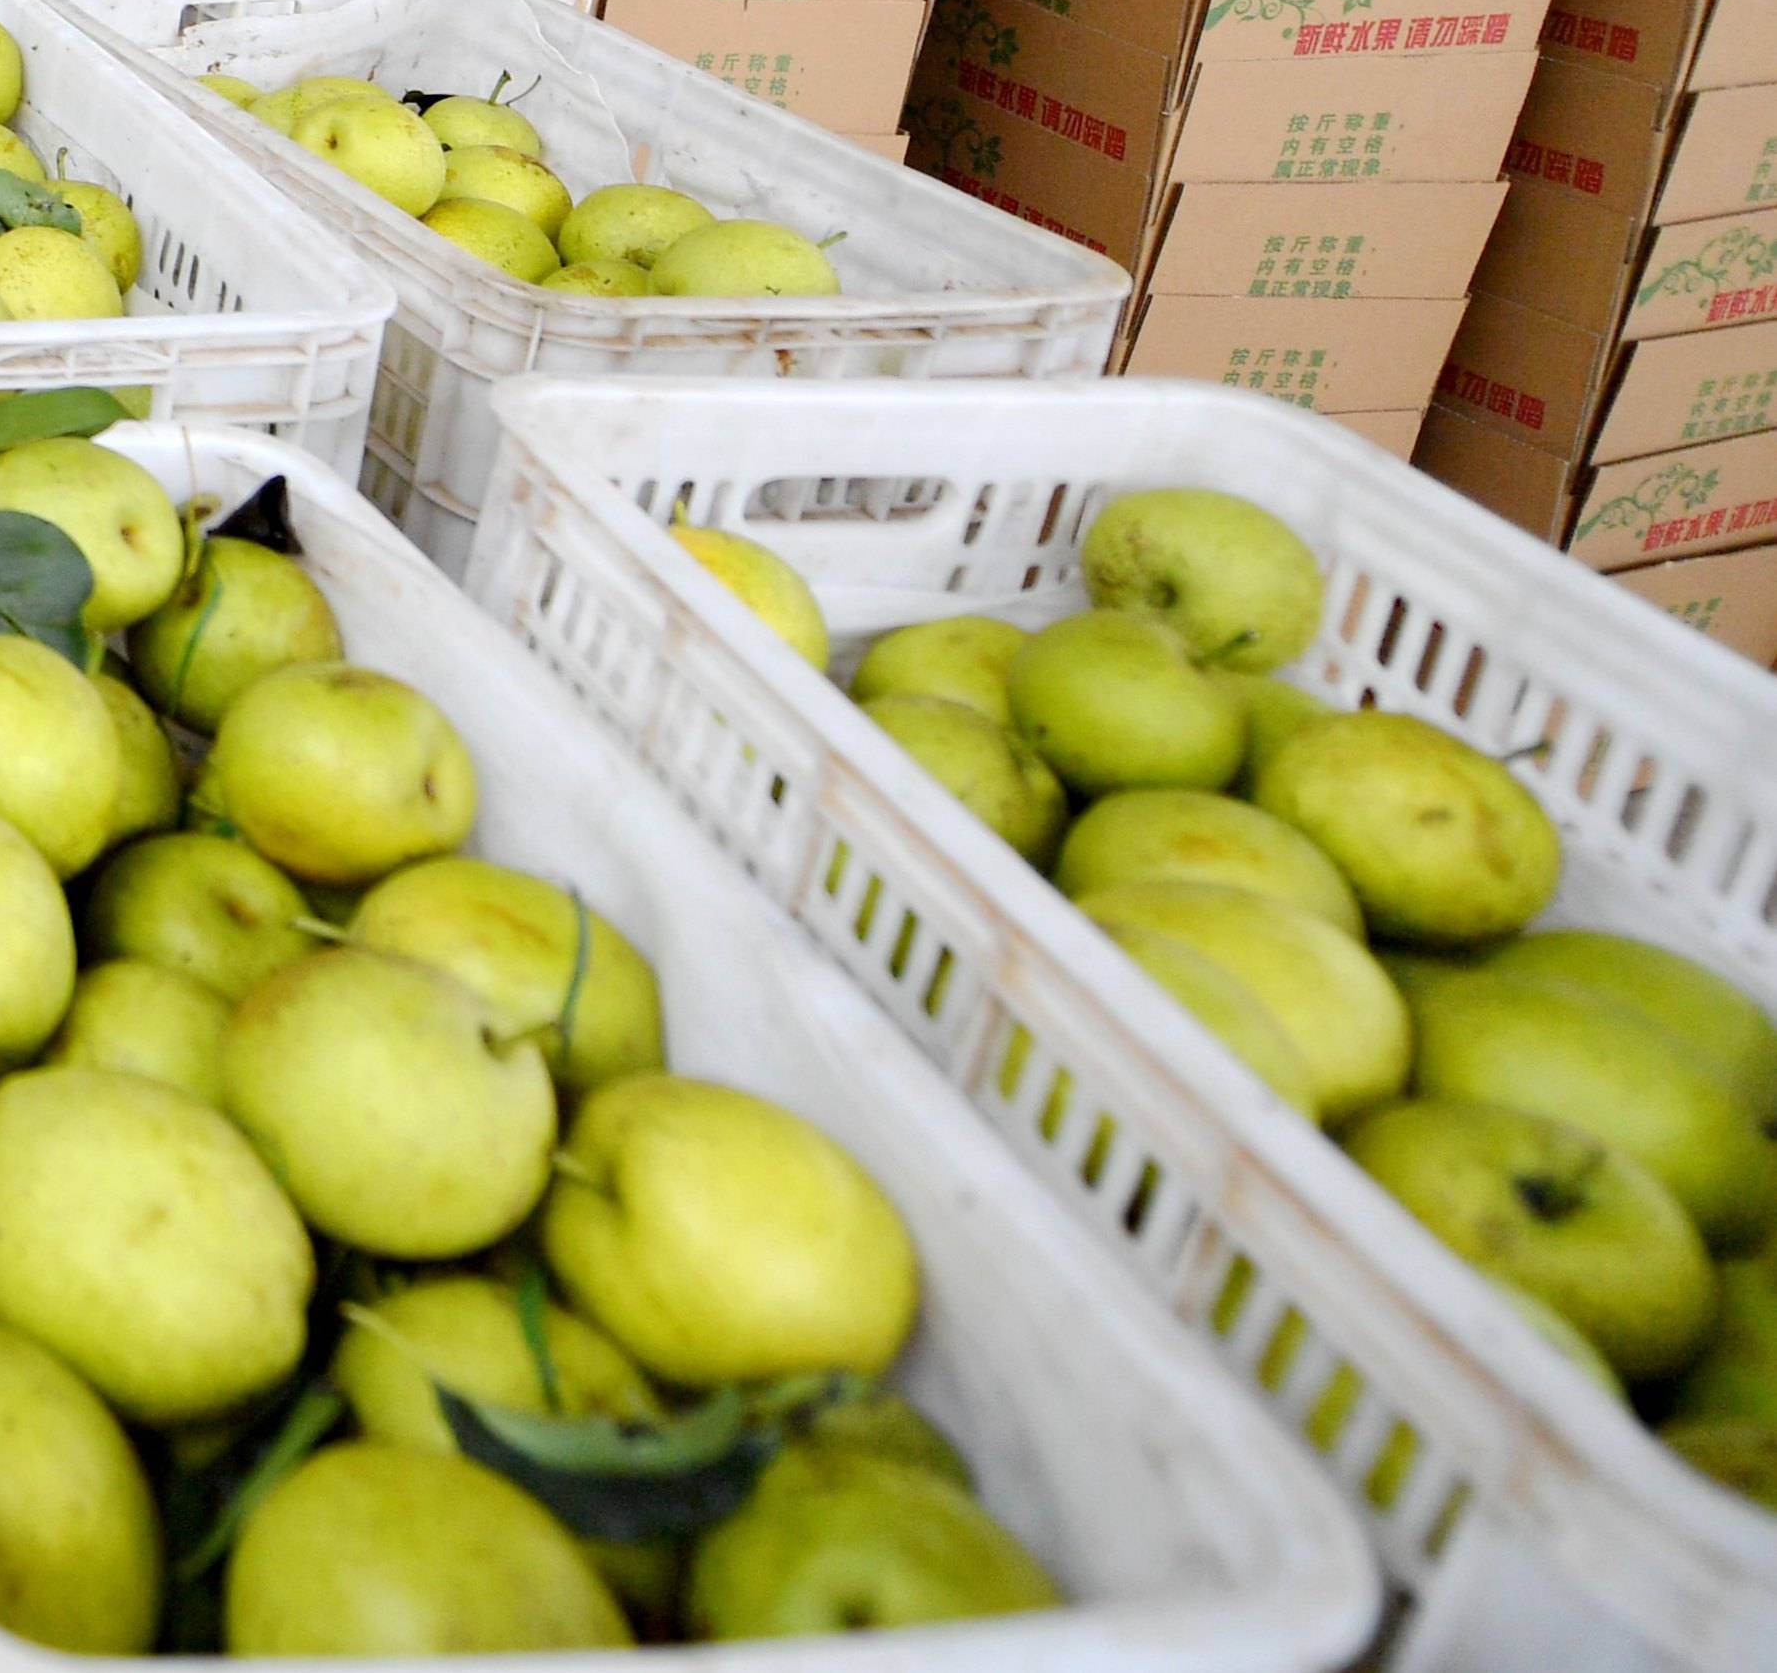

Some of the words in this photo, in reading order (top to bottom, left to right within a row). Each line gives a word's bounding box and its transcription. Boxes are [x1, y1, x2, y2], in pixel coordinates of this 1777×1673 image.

[1294, 17, 1405, 57] 新鲜水果
[1405, 13, 1513, 50] 请勿踩踏
[1643, 506, 1727, 553] 新鲜水果
